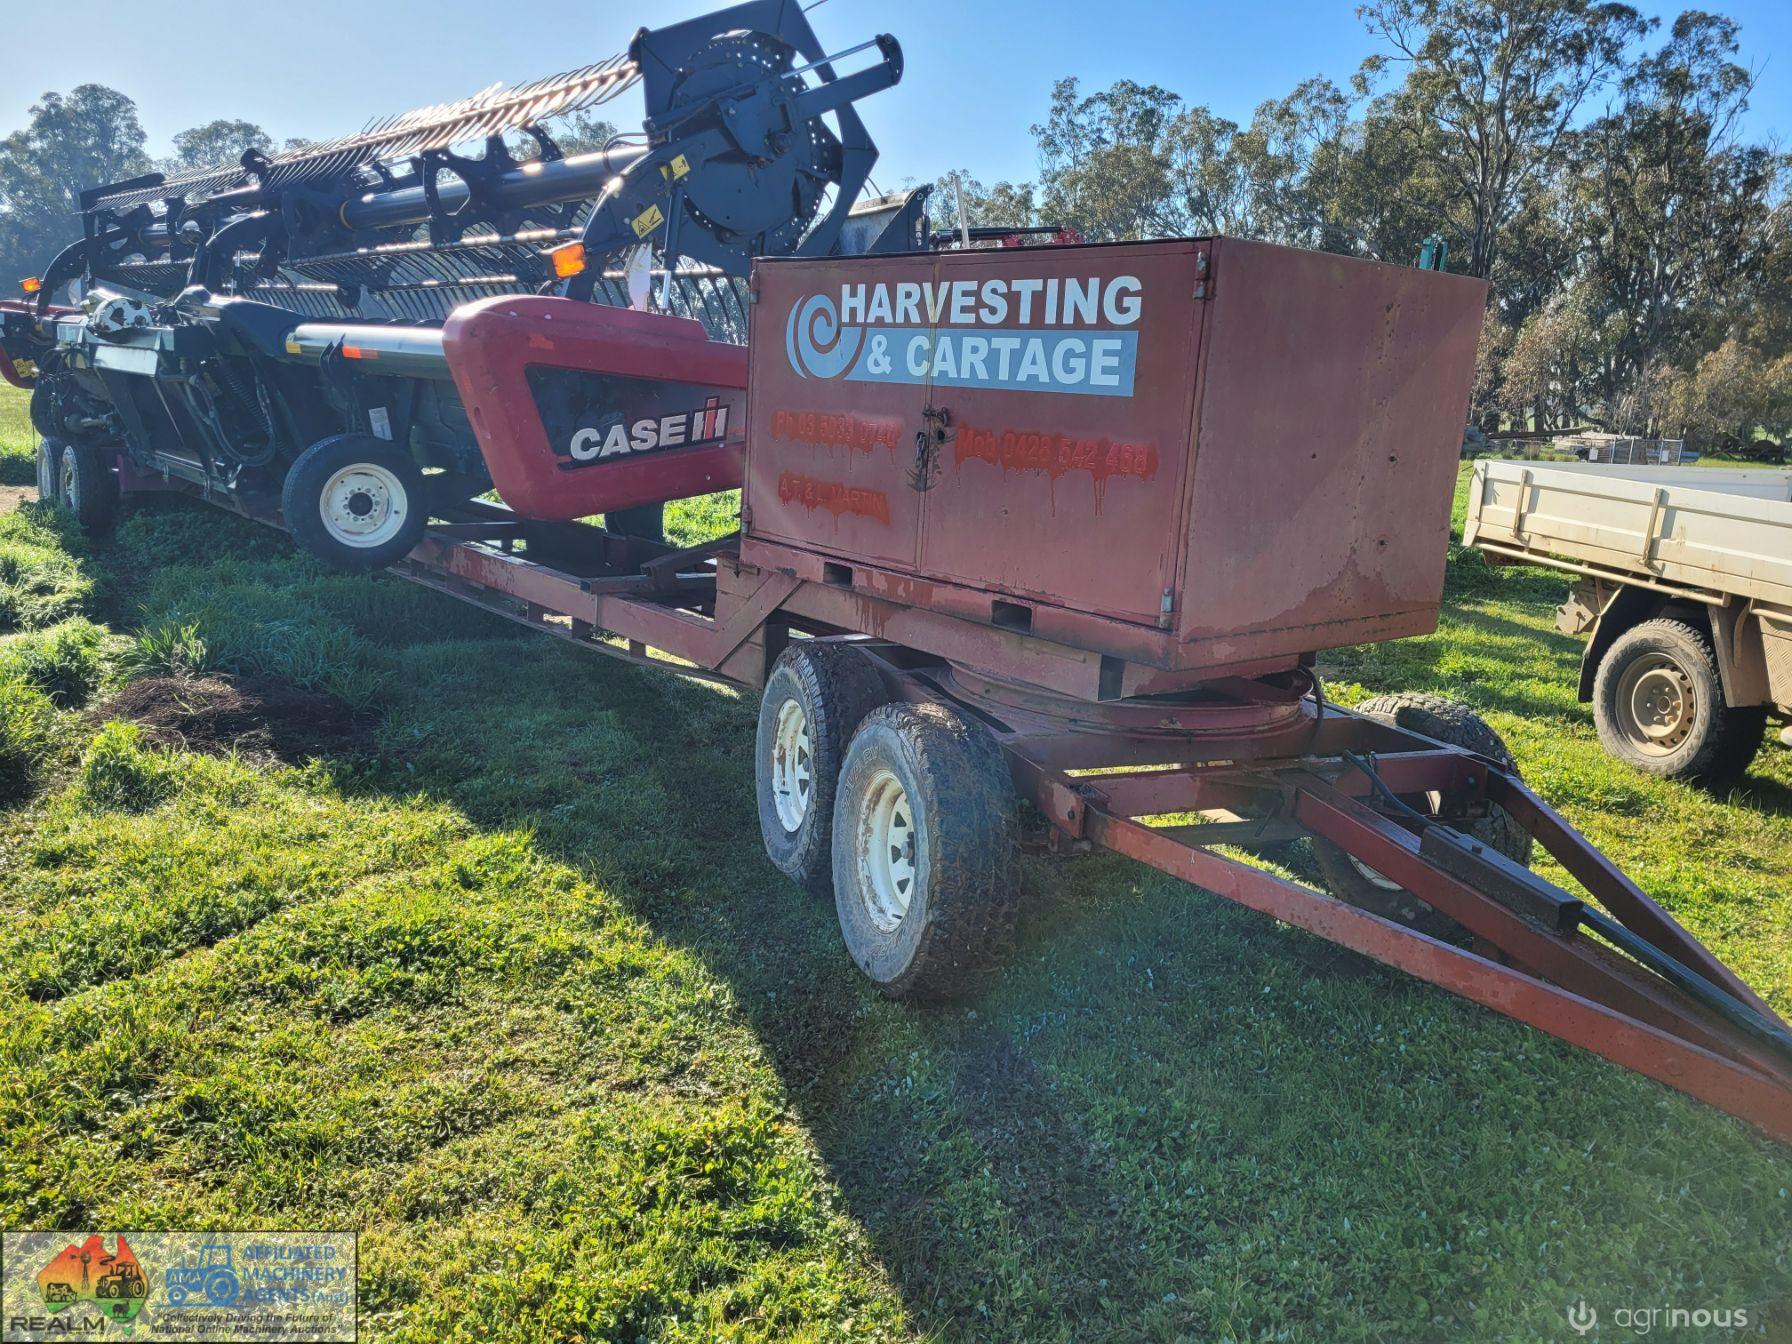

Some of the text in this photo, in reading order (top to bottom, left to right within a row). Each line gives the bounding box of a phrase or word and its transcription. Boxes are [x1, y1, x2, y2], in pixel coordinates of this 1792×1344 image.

[841, 275, 1142, 326] HARVESTING
[866, 334, 1122, 386] & CARTAGE
[570, 414, 688, 461] CASE
